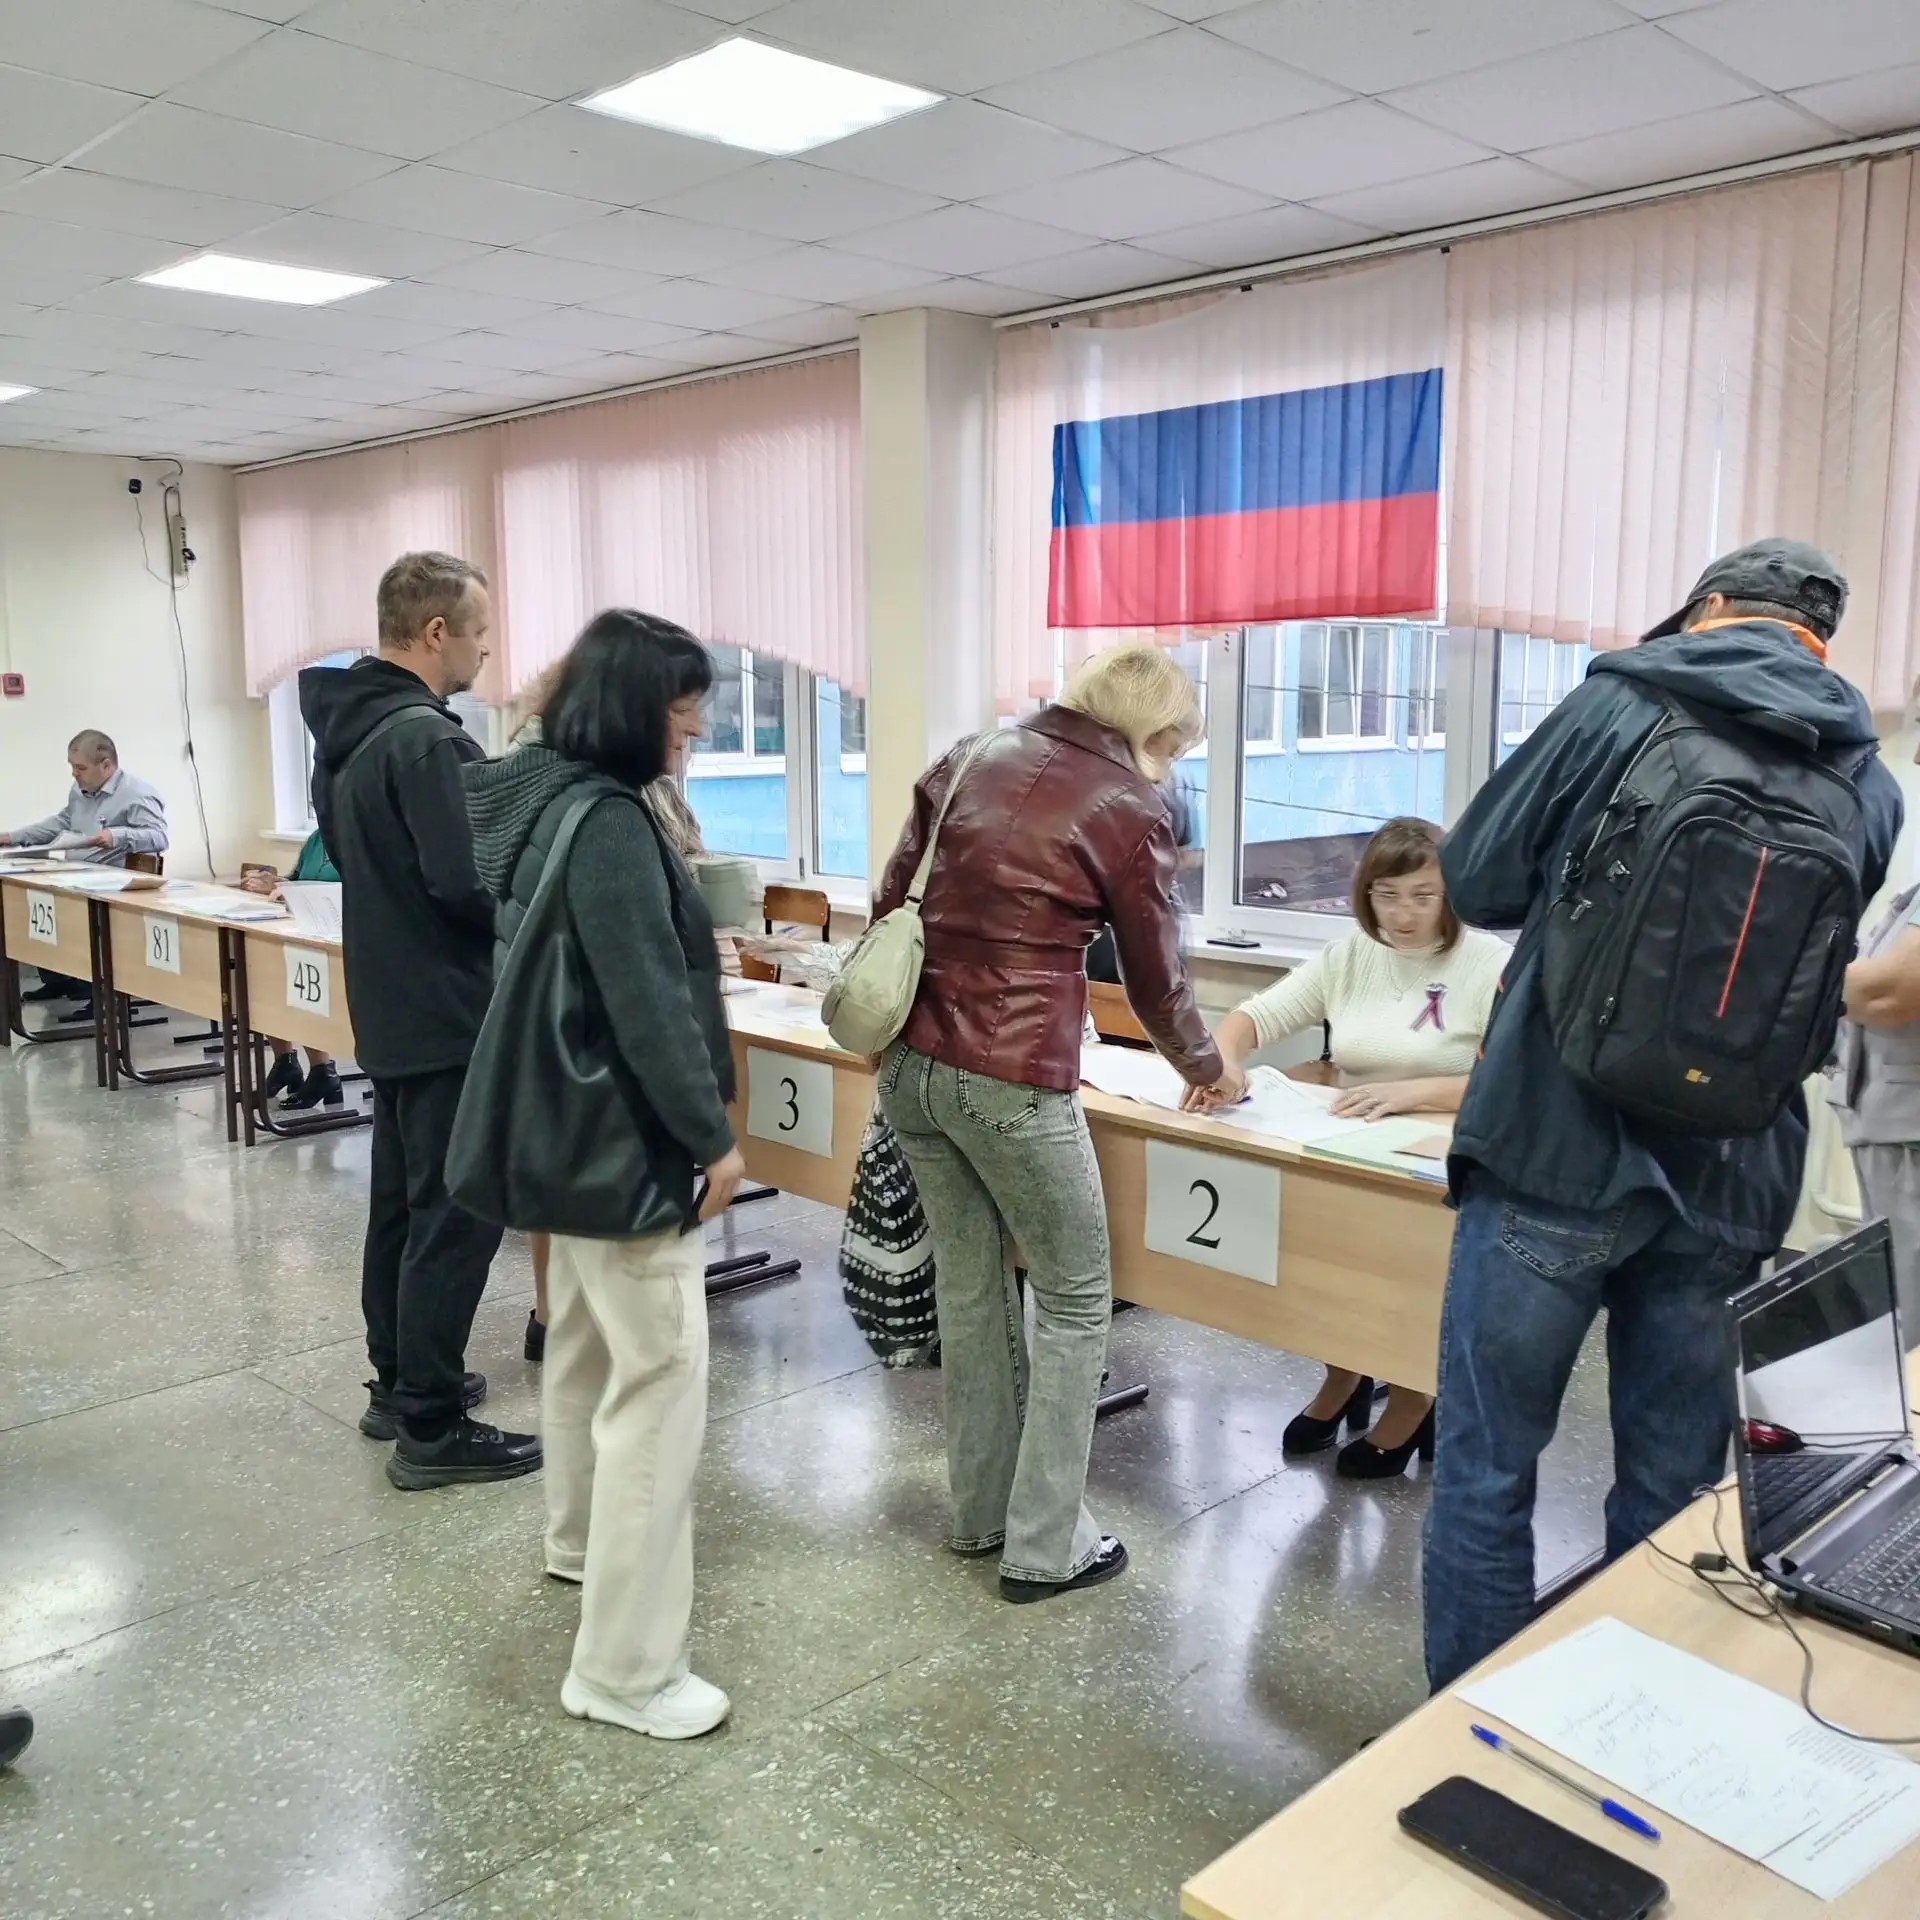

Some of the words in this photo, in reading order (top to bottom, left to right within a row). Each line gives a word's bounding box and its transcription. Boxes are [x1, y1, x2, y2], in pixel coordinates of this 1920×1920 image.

[31, 902, 54, 935] 425
[153, 925, 170, 962] 81
[777, 1076, 800, 1131] 3
[1185, 1178, 1222, 1250] 2
